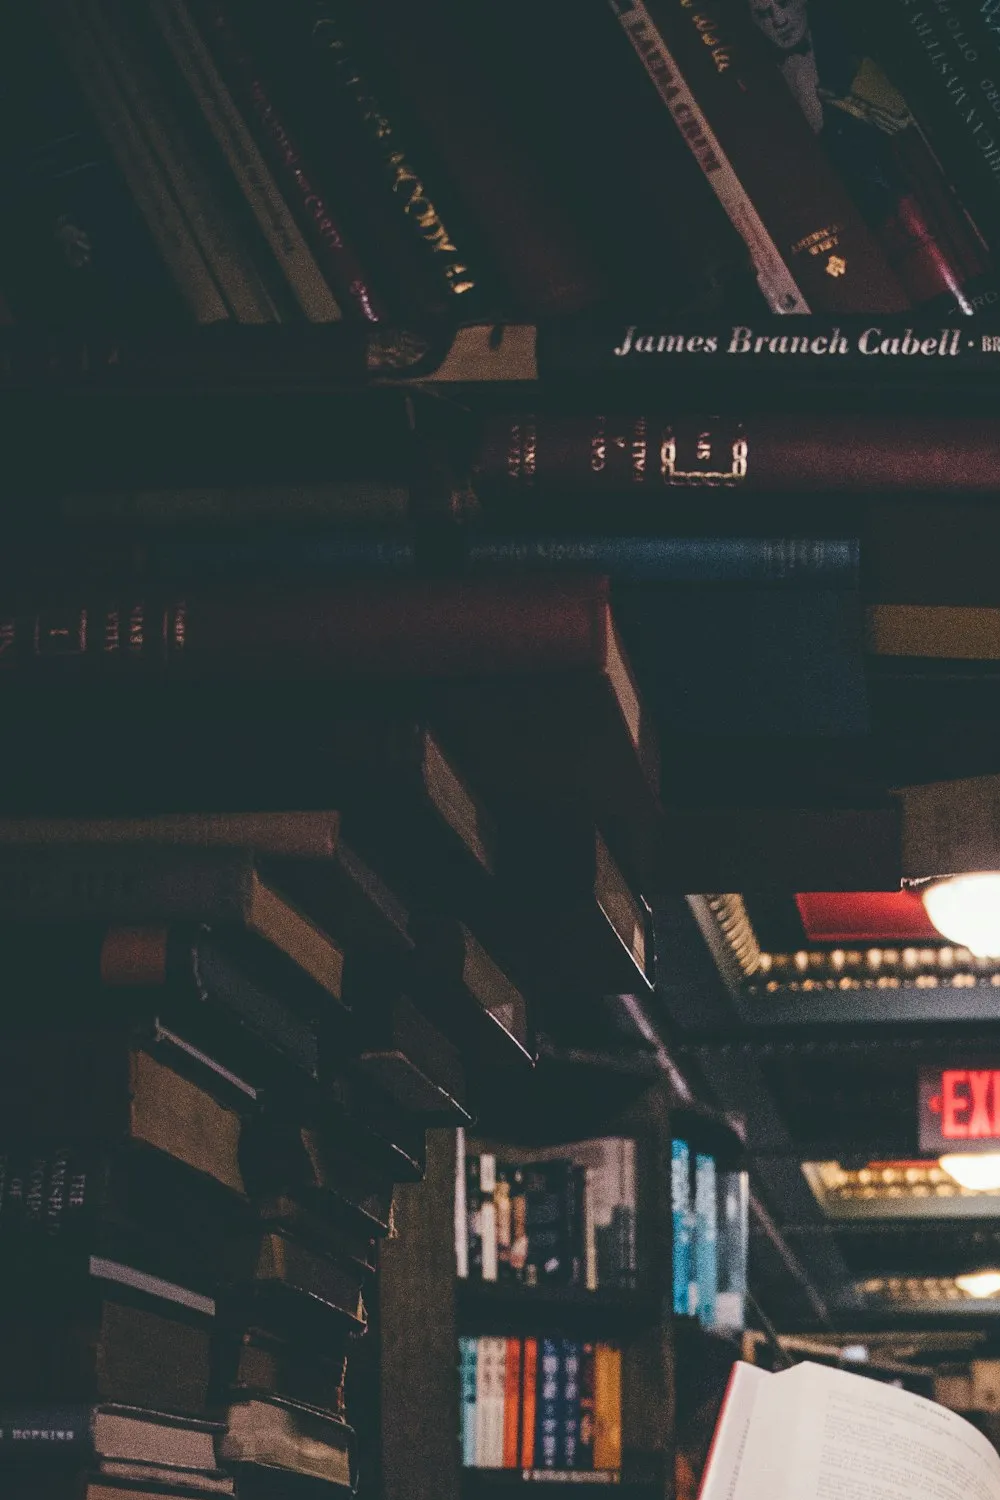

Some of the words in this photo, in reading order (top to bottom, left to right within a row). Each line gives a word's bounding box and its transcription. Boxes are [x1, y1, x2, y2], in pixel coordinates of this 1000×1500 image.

[614, 325, 718, 357] James
[727, 325, 849, 356] Branch
[857, 325, 962, 357] Cabell
